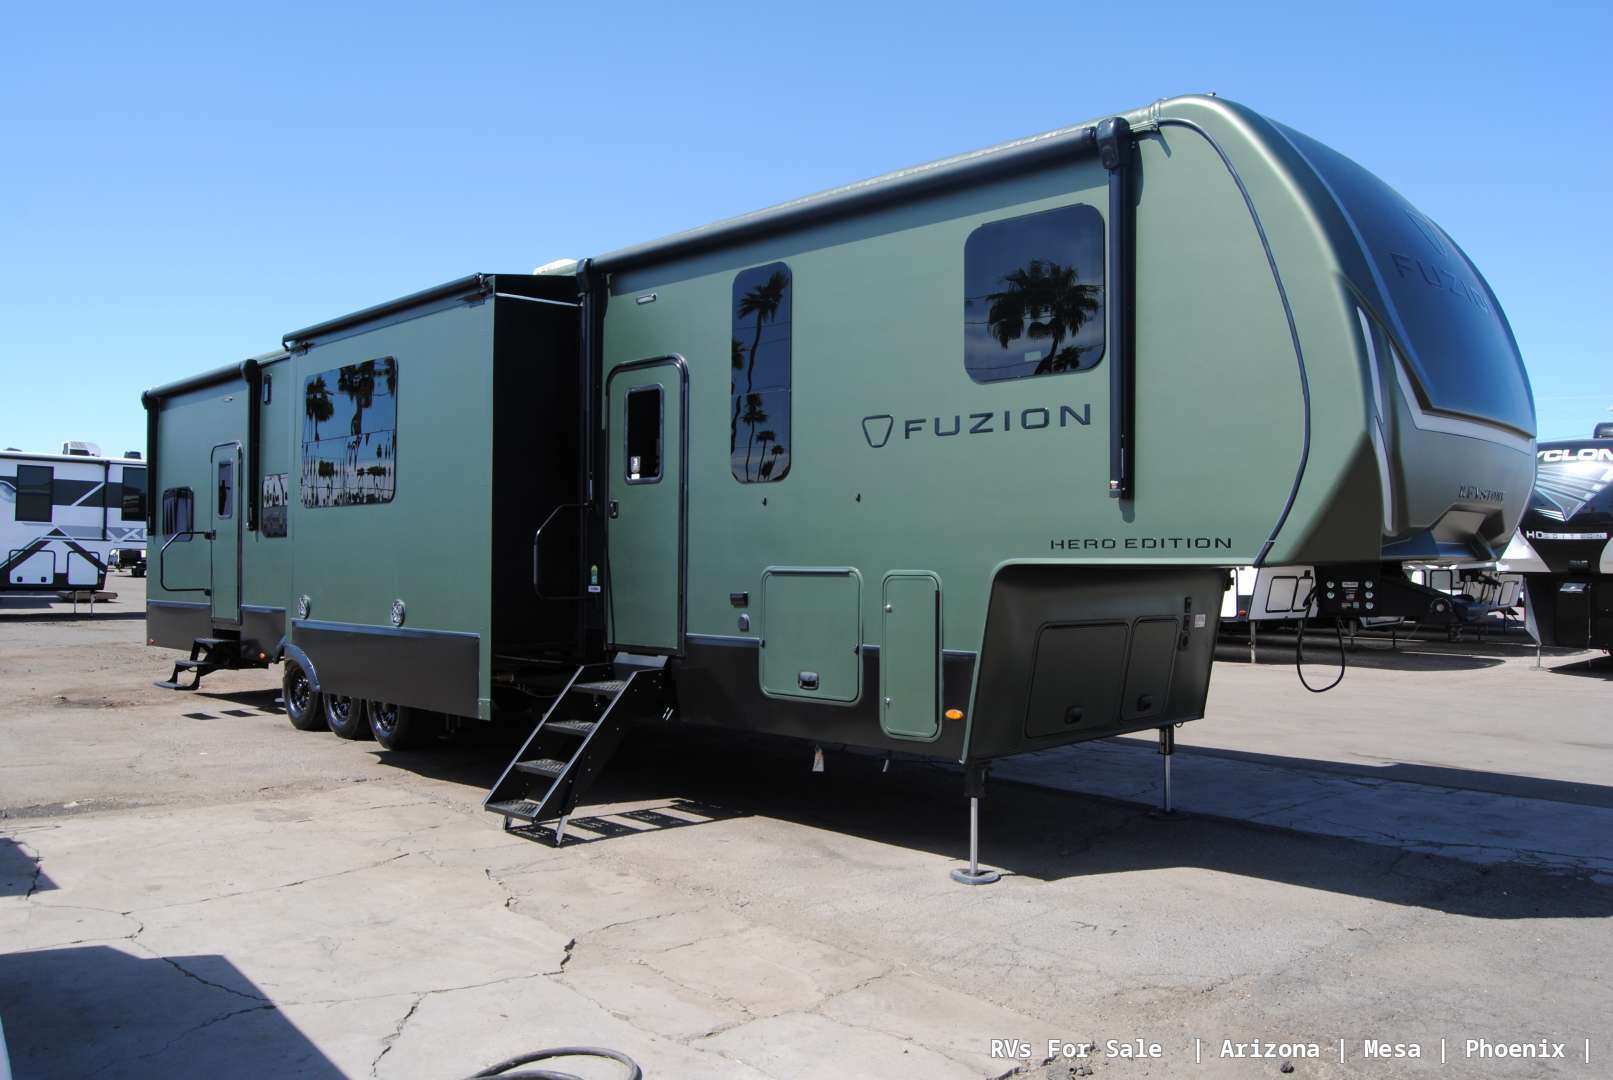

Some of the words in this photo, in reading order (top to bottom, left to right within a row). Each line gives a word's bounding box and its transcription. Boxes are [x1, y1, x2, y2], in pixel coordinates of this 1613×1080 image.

[1389, 252, 1489, 314] FUZIO
[904, 403, 1091, 440] FUZION
[1050, 538, 1116, 550] HERO
[1124, 537, 1232, 549] EDITION
